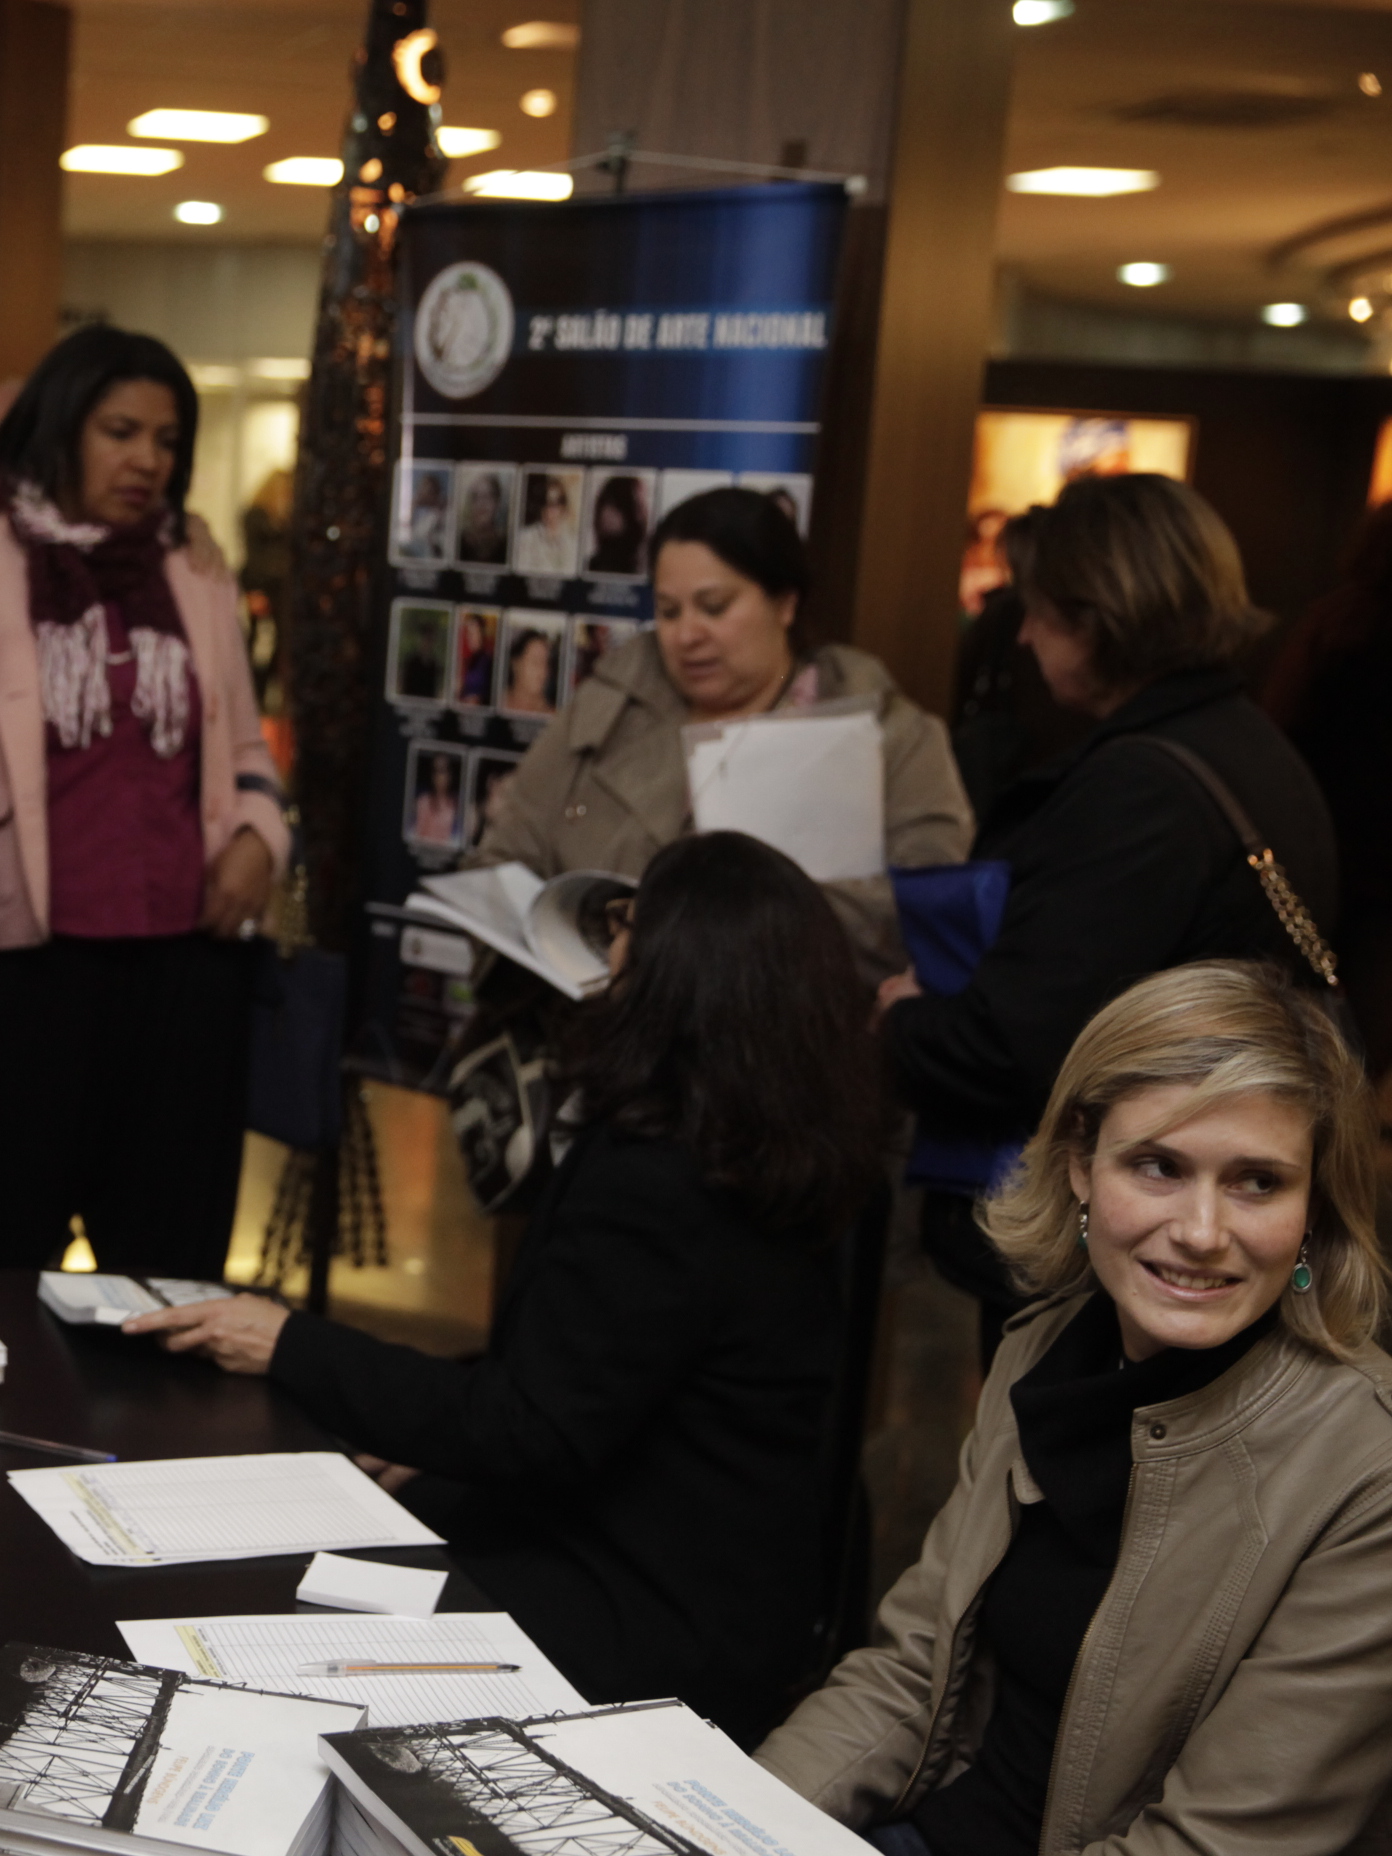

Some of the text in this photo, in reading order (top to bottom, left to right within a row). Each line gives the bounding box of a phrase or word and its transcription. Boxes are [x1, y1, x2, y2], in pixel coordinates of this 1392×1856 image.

[555, 308, 622, 350] SALÃO
[623, 313, 655, 349] DE
[656, 312, 710, 349] ARTE
[712, 311, 827, 348] NACIONAL
[219, 1748, 236, 1759] DO
[227, 1751, 255, 1777] PONTE
[683, 1780, 727, 1807] PONTE
[192, 1812, 215, 1830] LUZ
